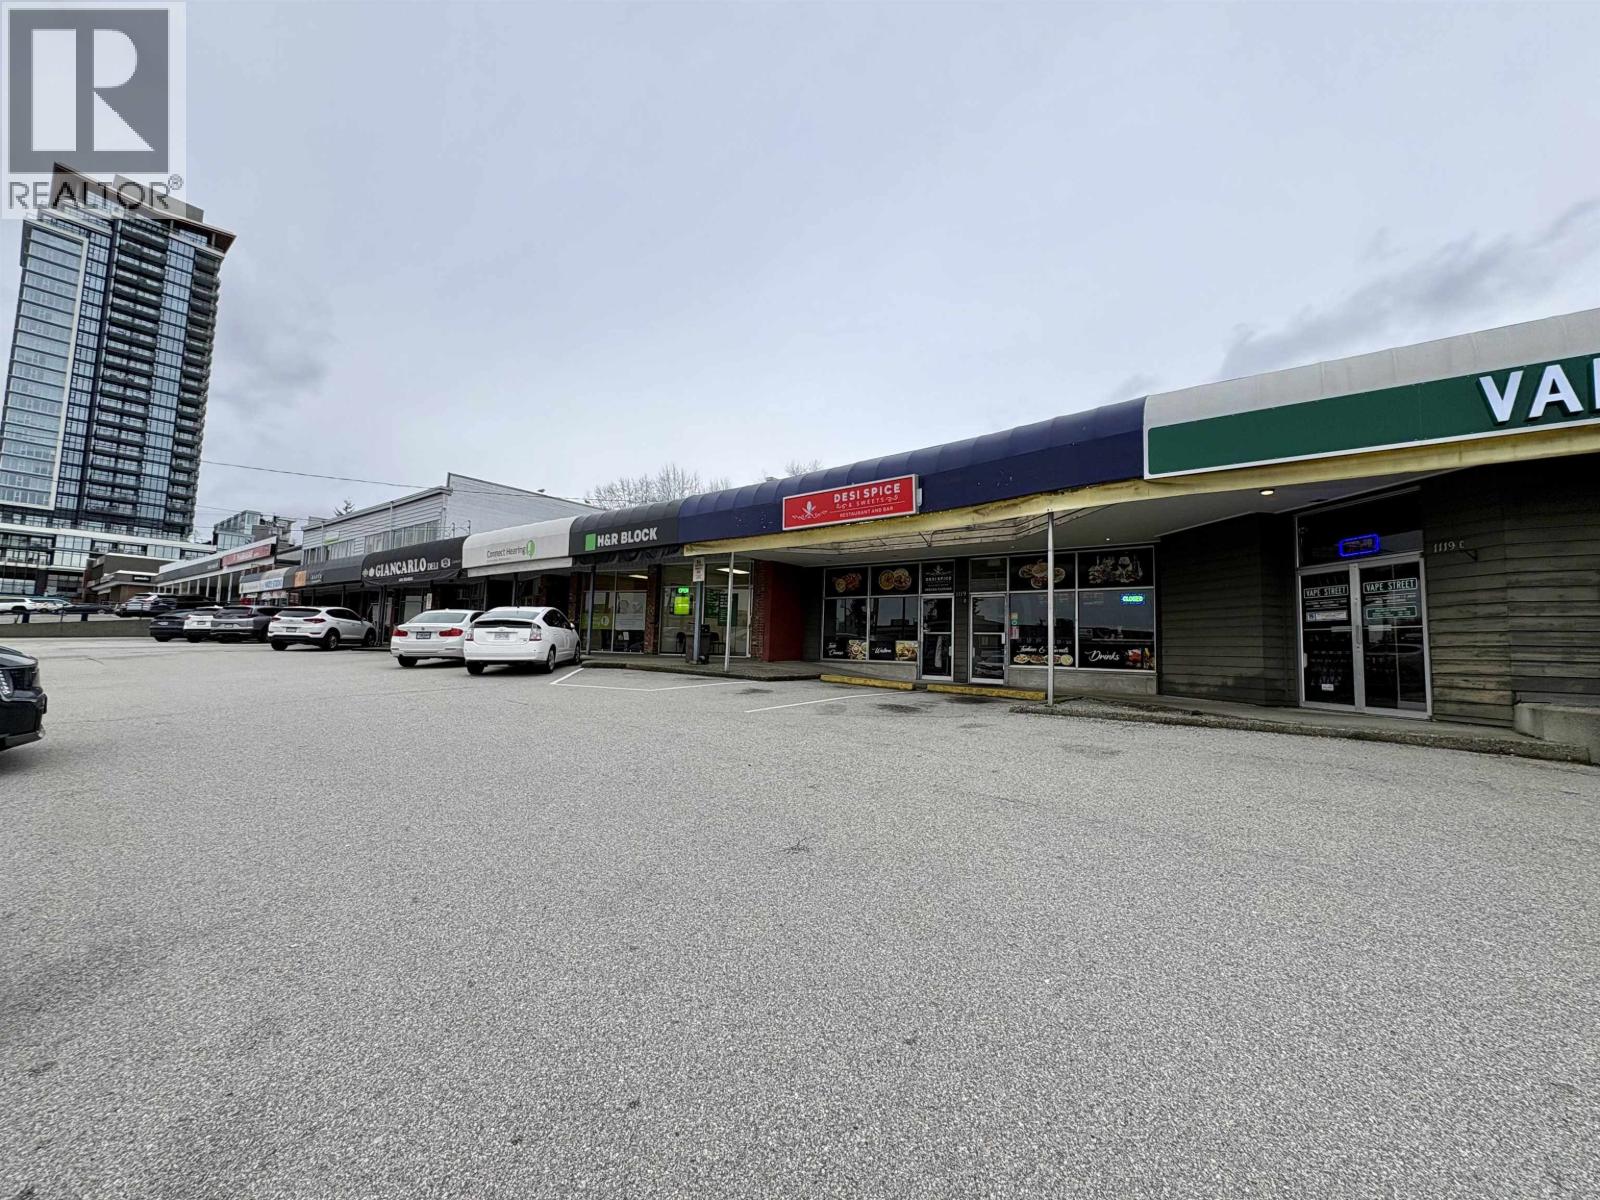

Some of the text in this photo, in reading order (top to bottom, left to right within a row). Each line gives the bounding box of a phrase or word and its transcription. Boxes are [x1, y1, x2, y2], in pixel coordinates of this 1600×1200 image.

[833, 483, 901, 504] DESI SPICE
[856, 496, 885, 507] SWEETS
[839, 509, 870, 518] RESTAURANT
[597, 527, 658, 548] H&R BLOCK
[486, 545, 526, 559] Connect Hearing
[375, 557, 427, 578] GIANCARLO
[1366, 579, 1415, 592] VAPE STREET
[1084, 650, 1120, 662] Drinks
